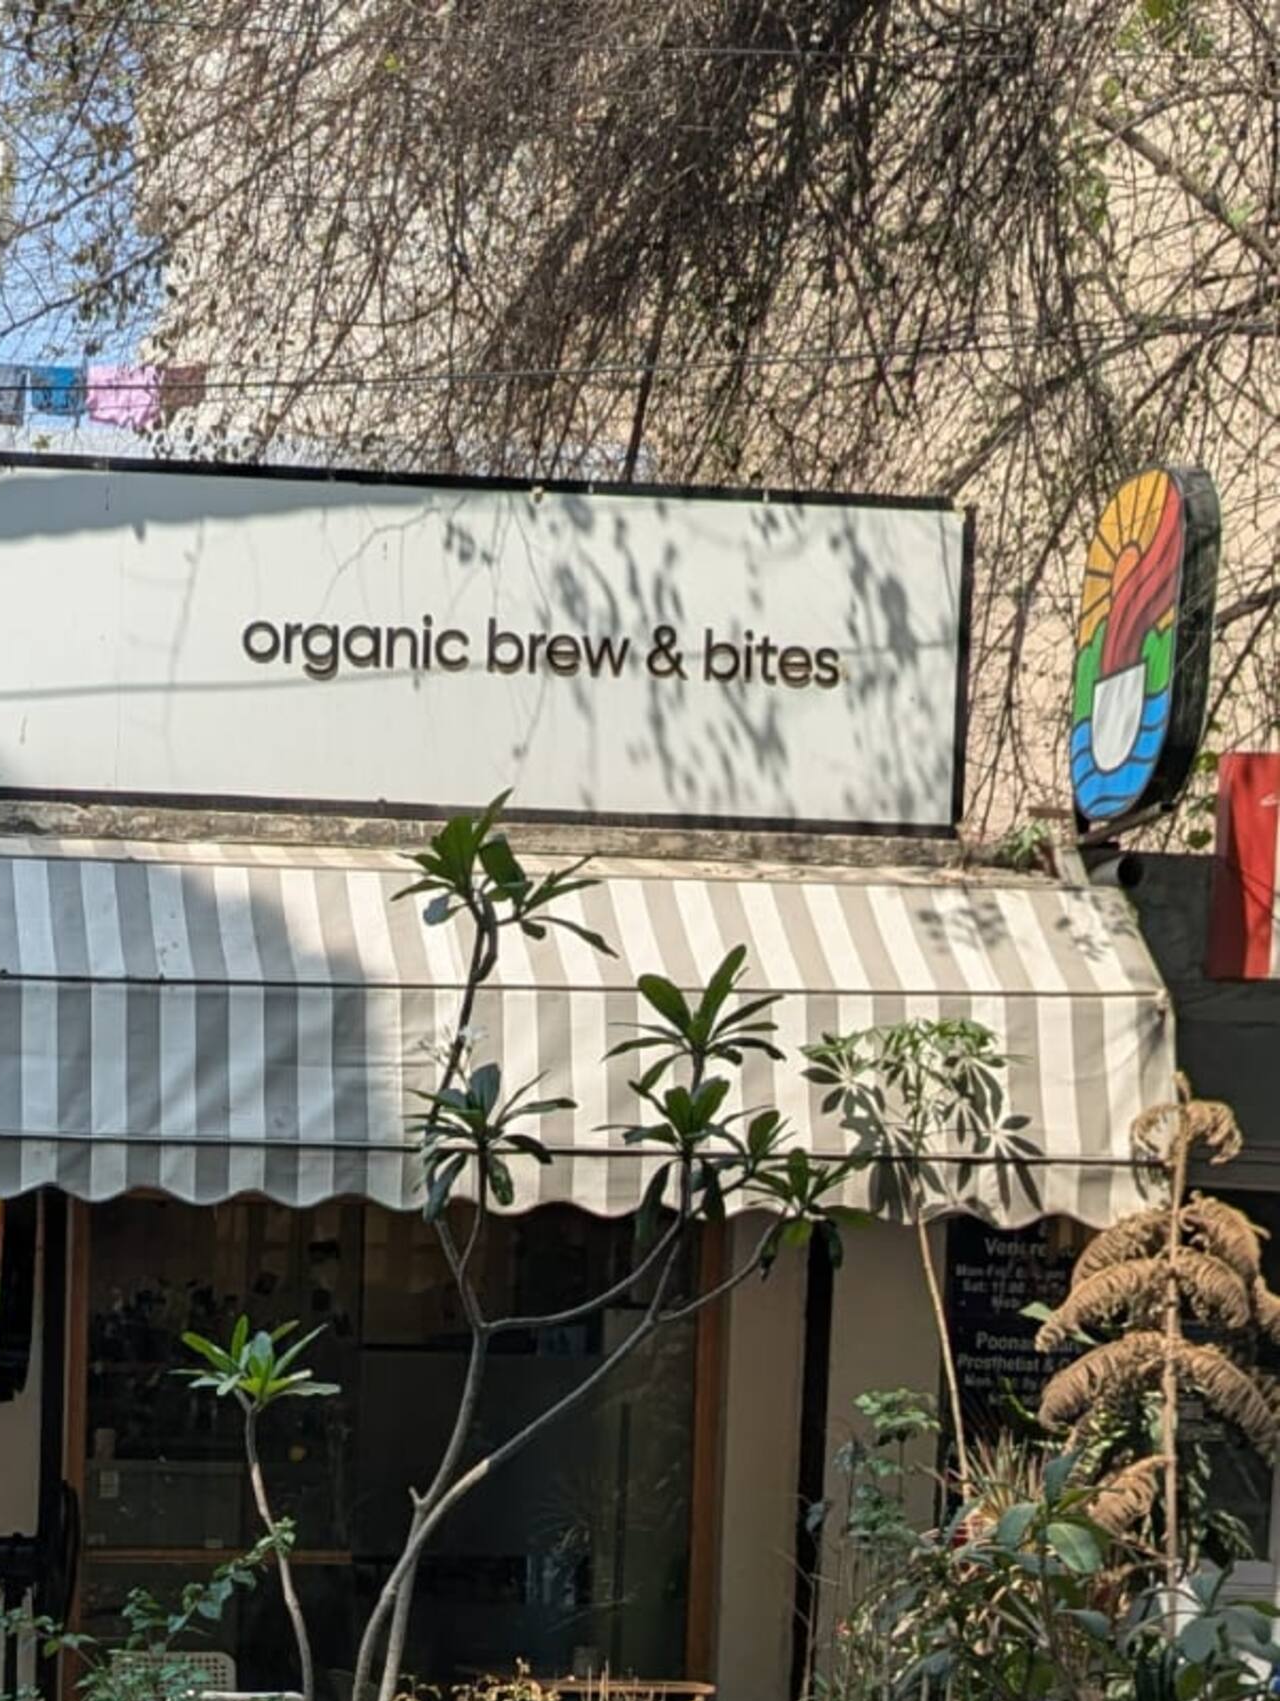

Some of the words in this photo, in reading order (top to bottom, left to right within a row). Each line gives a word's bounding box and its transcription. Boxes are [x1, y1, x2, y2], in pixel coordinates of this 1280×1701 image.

[242, 613, 470, 682] organic
[486, 616, 631, 678] brew
[645, 624, 689, 681] &
[703, 627, 841, 689] bites
